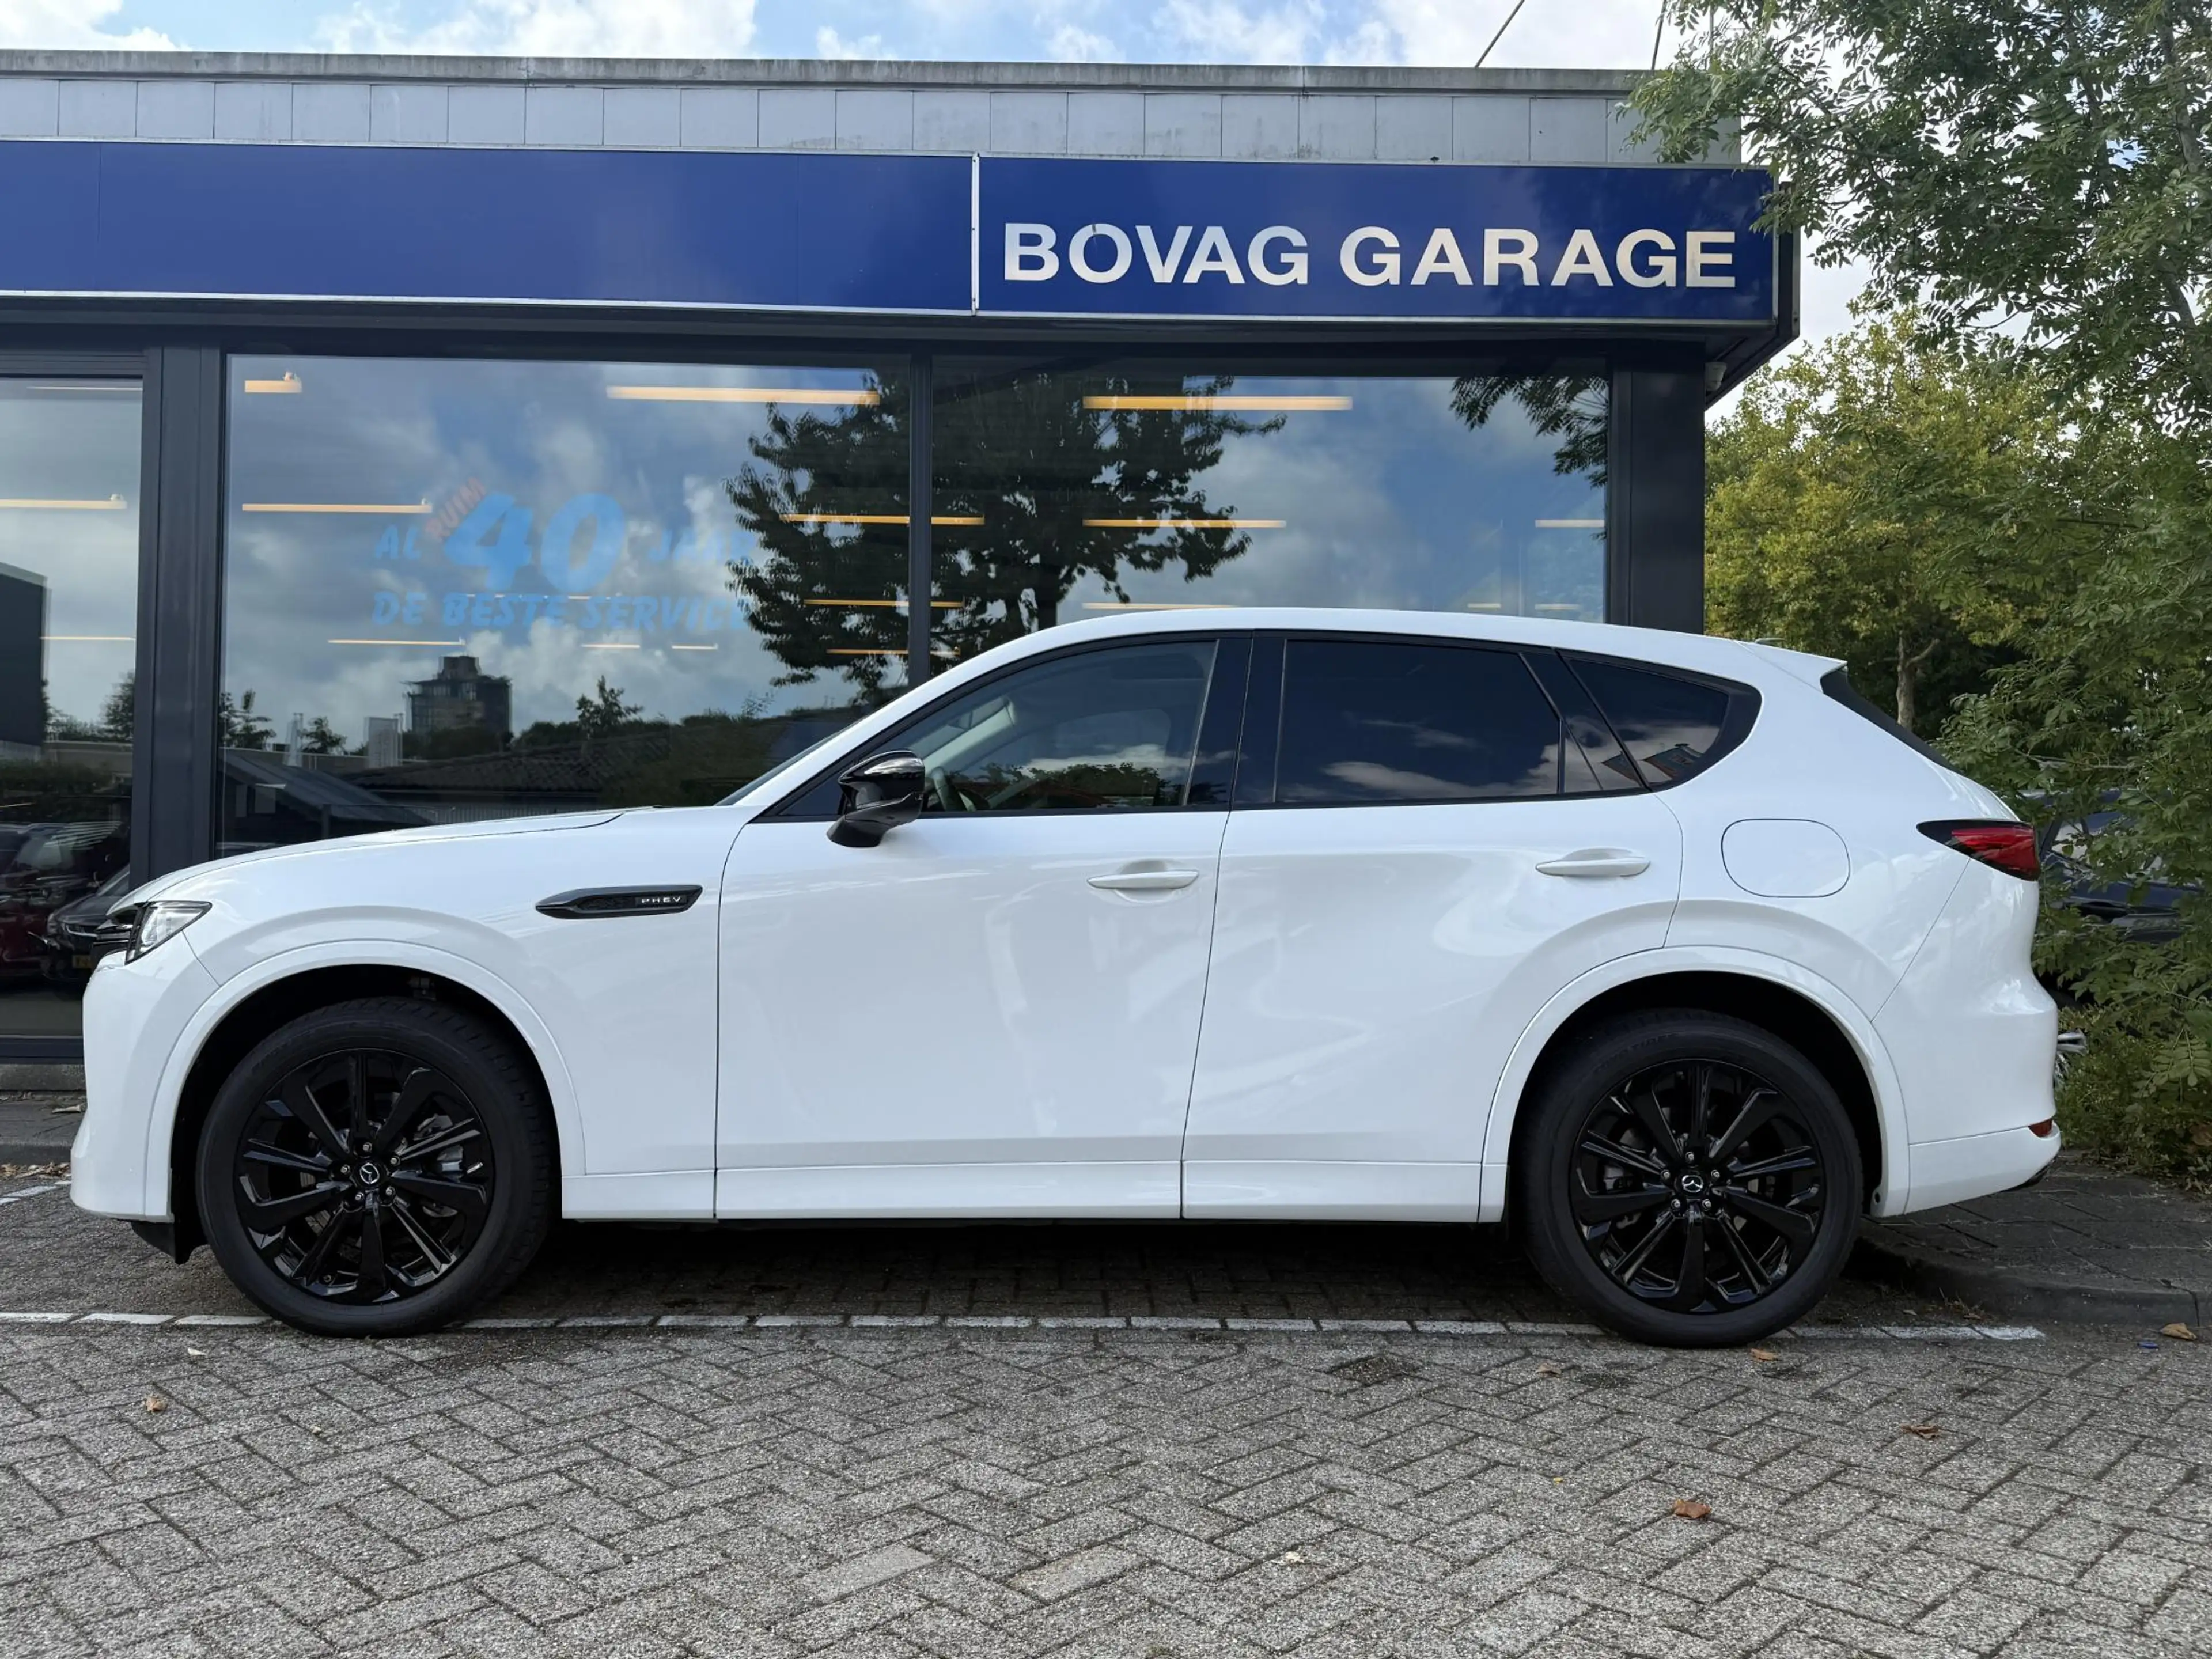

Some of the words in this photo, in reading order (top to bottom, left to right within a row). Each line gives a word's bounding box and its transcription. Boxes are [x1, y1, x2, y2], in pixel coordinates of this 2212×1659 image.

[1003, 223, 1309, 285] BOVAG
[1339, 226, 1736, 288] GARAGE
[374, 525, 422, 560] AL
[425, 477, 486, 543] RUIM
[444, 492, 627, 593] 40
[372, 592, 427, 626] DE
[442, 593, 570, 628] BESTE
